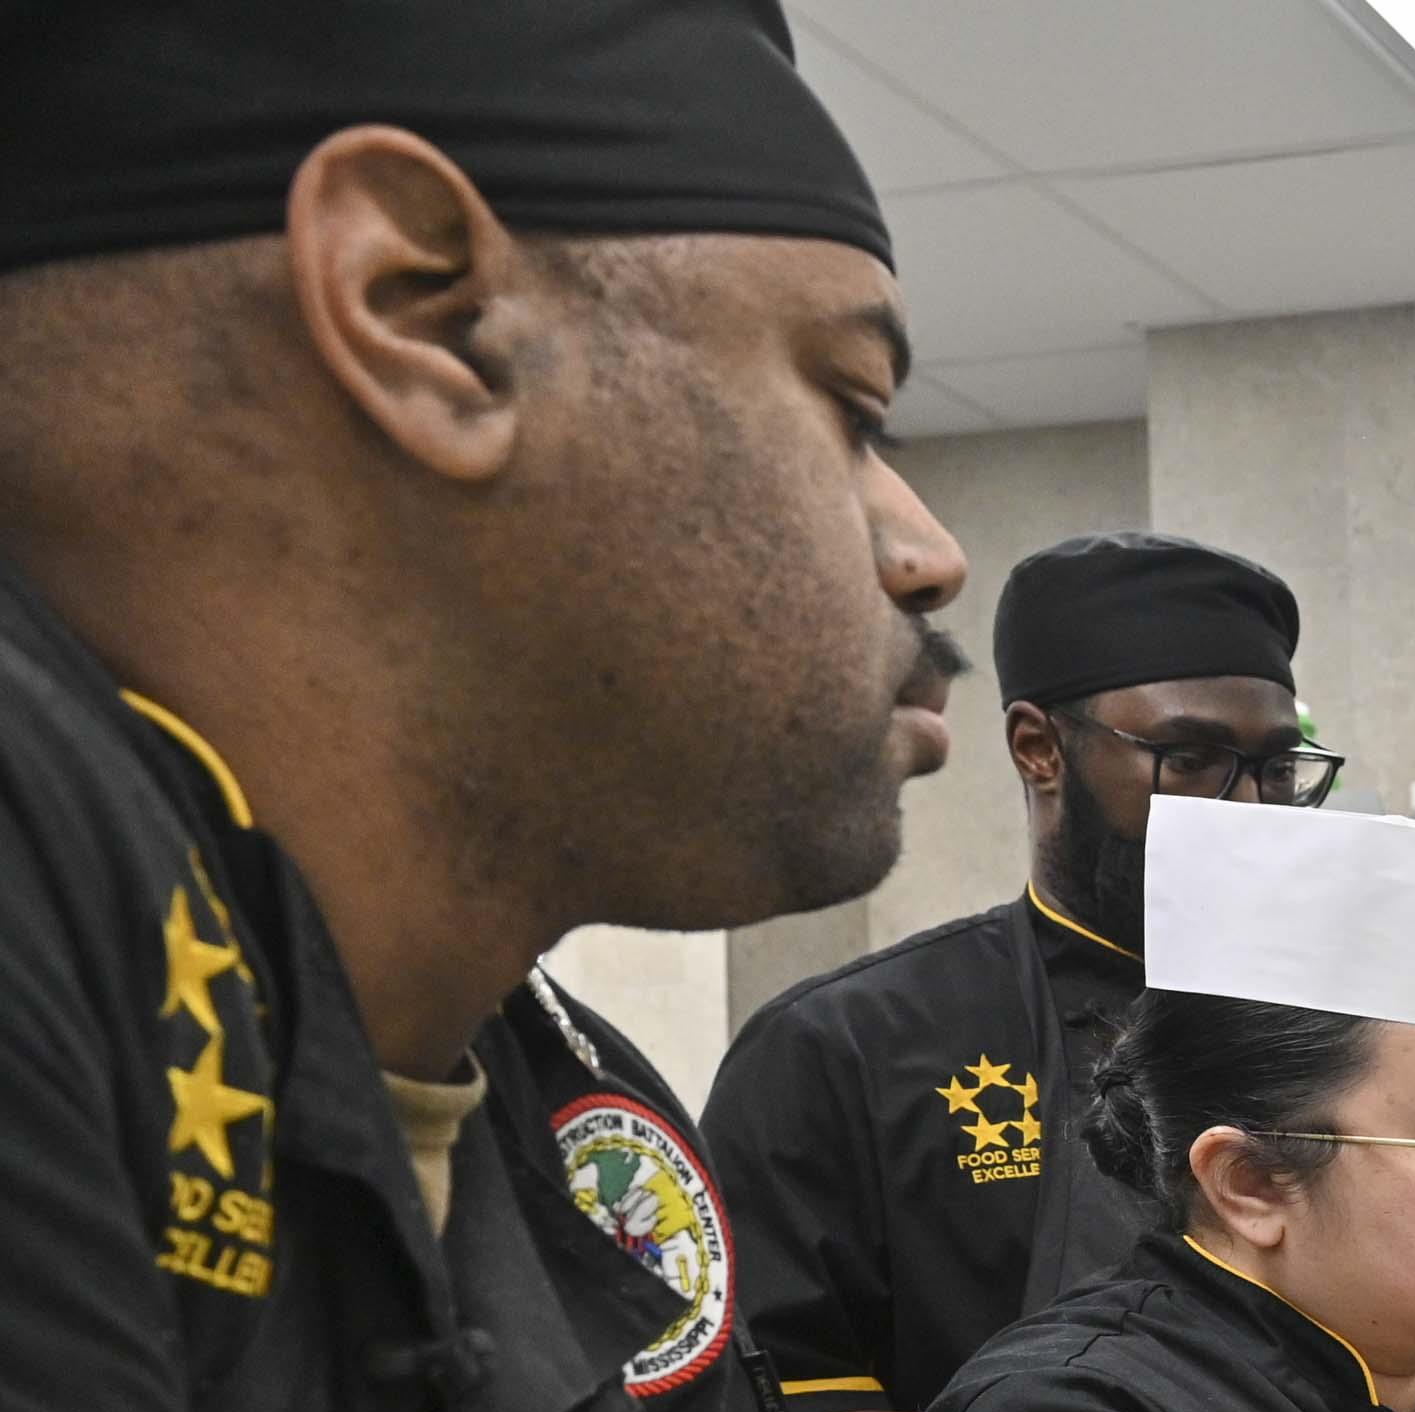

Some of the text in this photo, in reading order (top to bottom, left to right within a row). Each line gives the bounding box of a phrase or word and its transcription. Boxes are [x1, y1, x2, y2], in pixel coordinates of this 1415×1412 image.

[957, 1147, 1041, 1170] FOOD SER
[971, 1162, 1041, 1184] EXCELLE
[692, 1187, 722, 1262] CENTER
